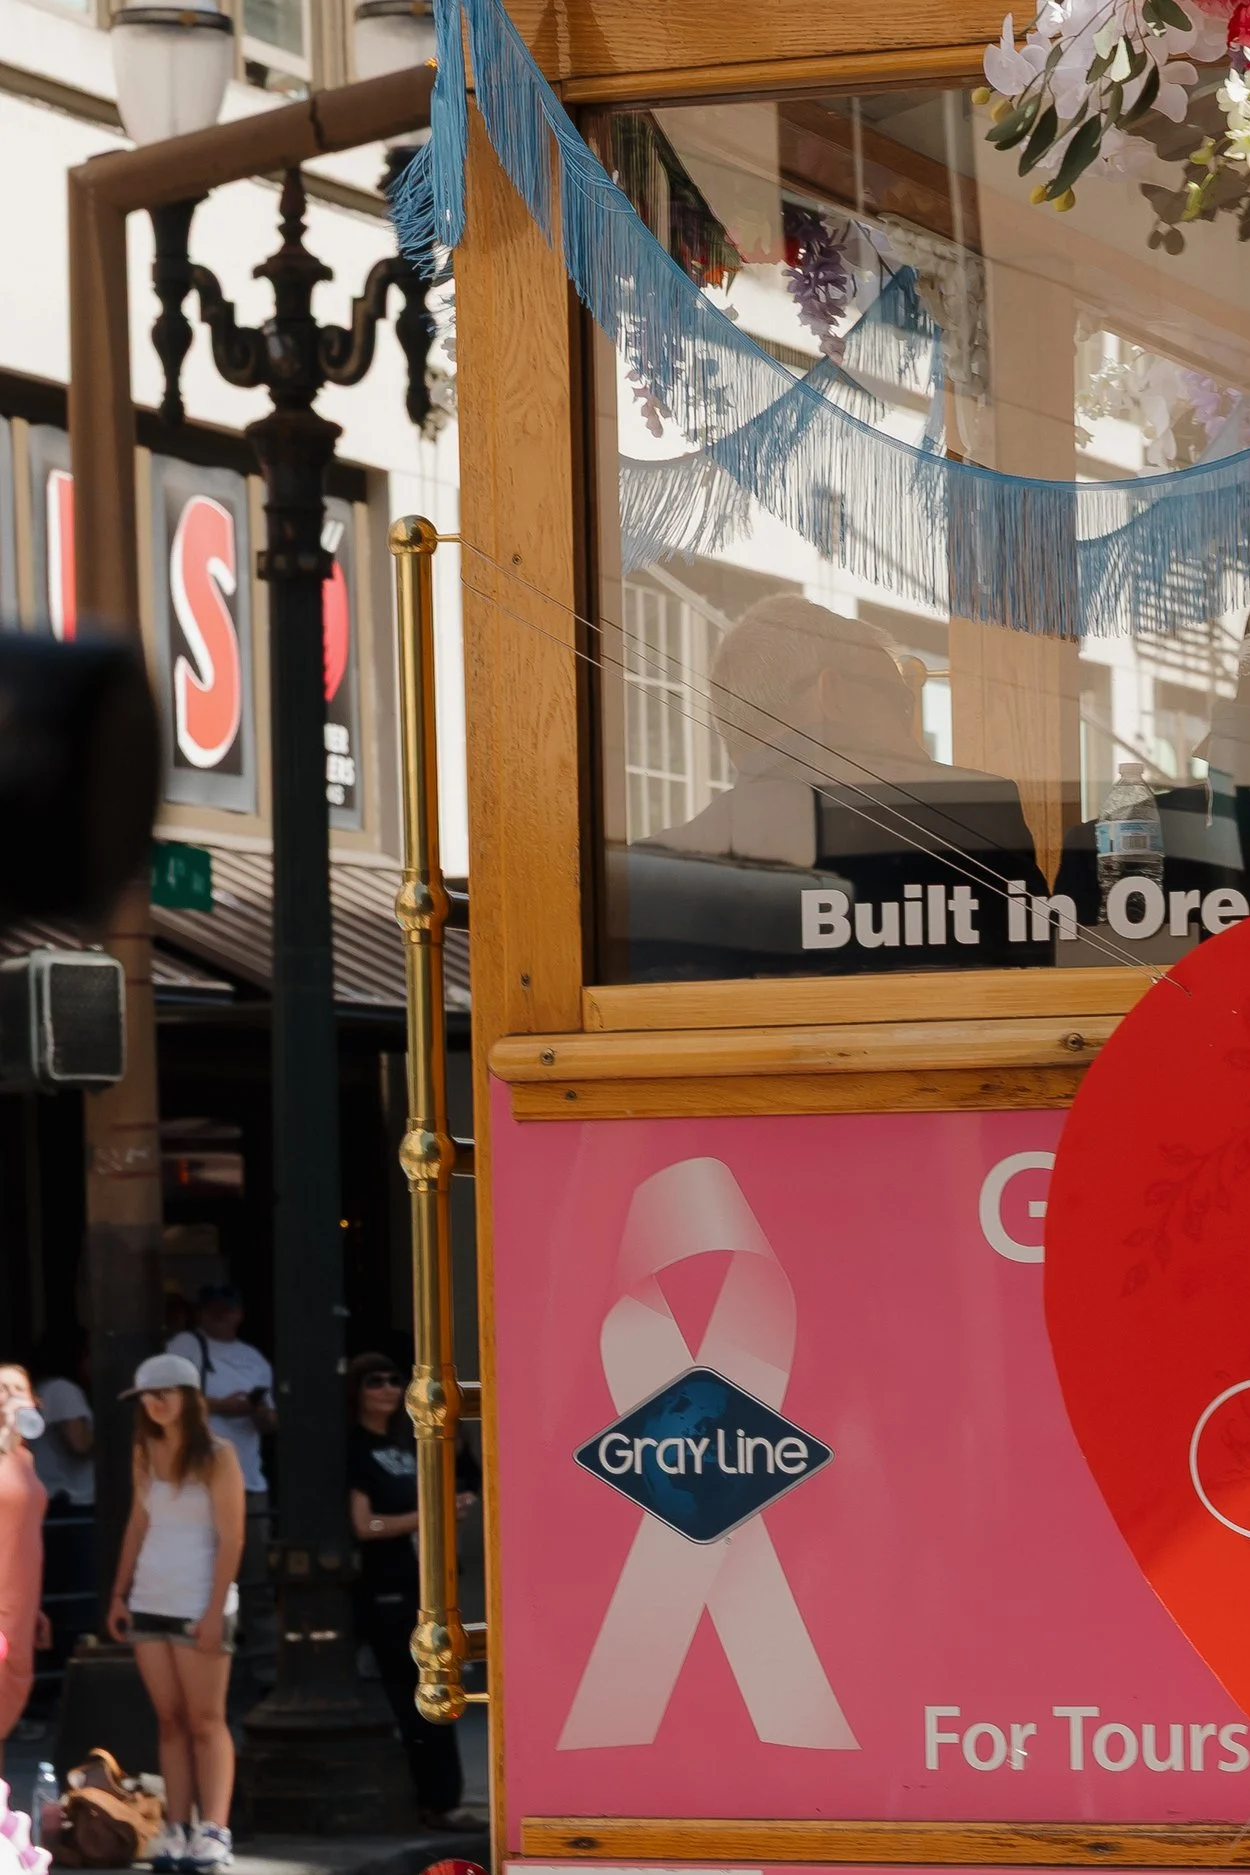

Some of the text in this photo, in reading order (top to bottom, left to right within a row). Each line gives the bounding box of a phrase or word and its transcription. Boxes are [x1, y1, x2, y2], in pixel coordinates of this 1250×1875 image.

[801, 884, 980, 951] Built
[1007, 881, 1078, 944] in
[924, 1705, 1037, 1772] For
[1053, 1706, 1250, 1773] Tours
